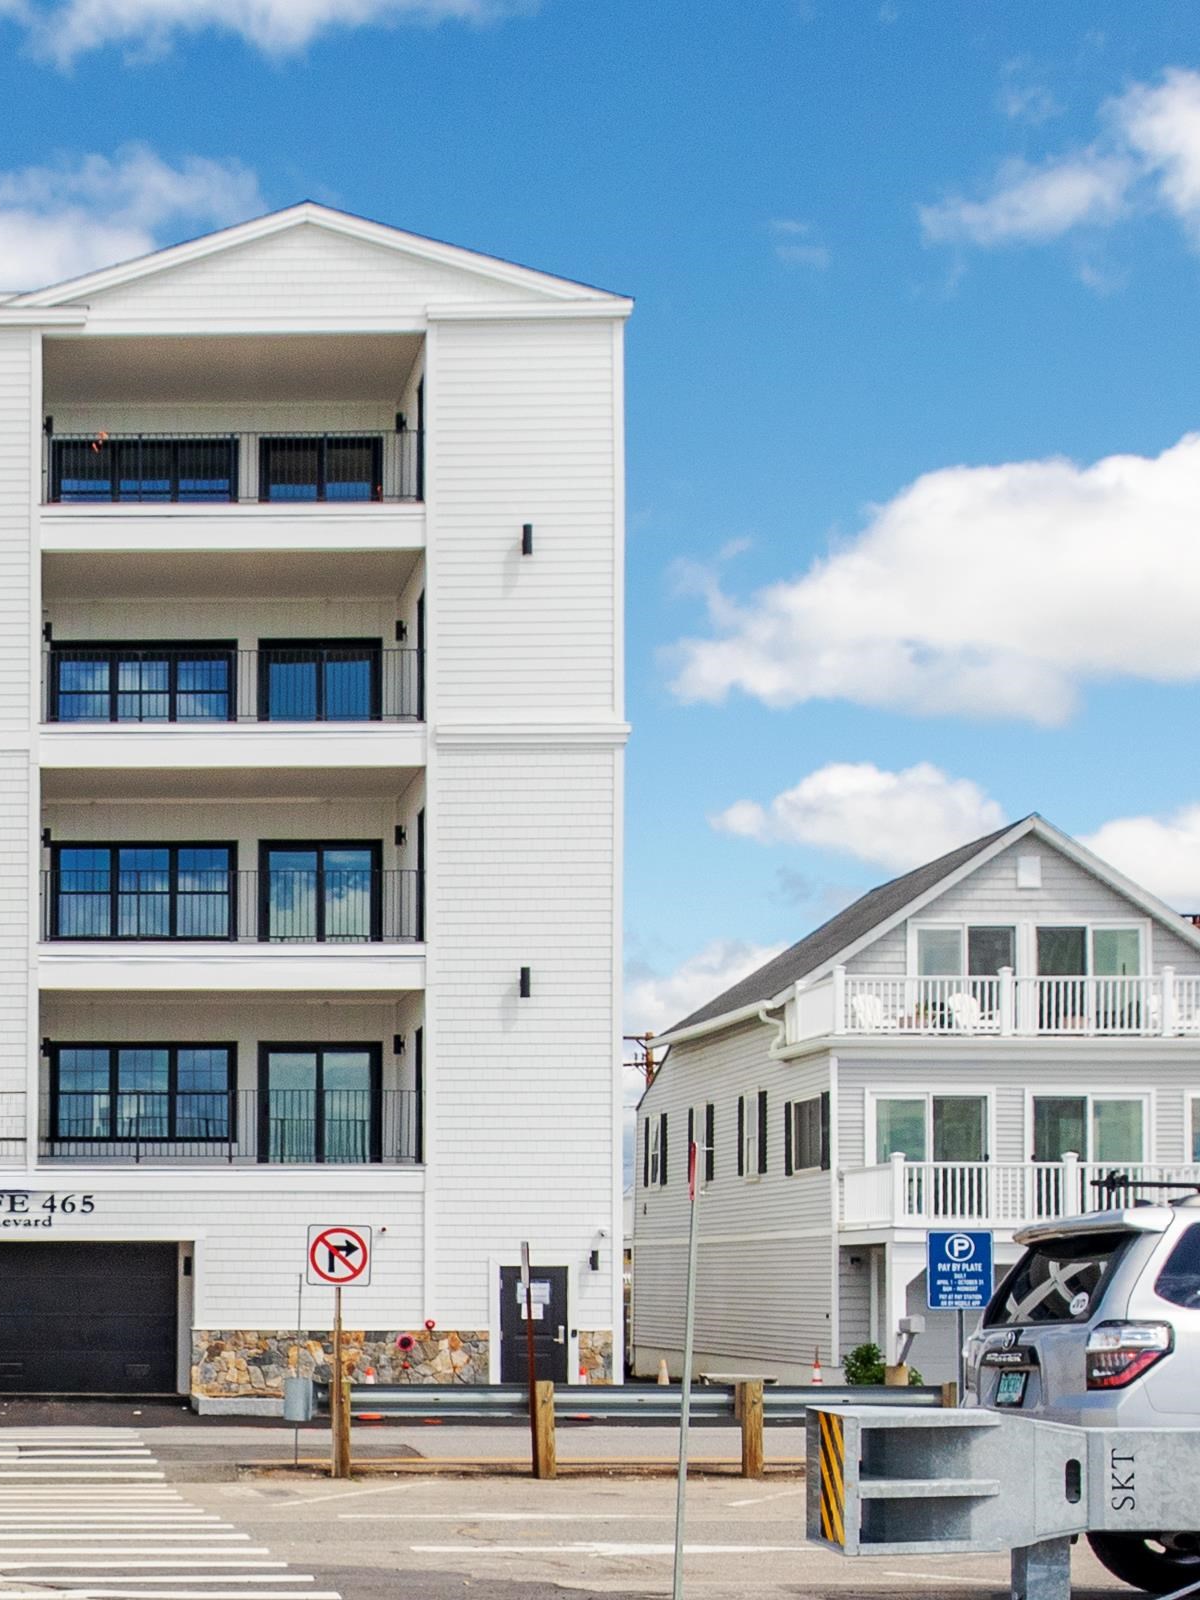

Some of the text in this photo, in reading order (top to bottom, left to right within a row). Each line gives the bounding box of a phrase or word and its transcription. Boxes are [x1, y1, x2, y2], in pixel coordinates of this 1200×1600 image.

[42, 1194, 96, 1213] 465
[953, 1238, 970, 1257] P
[937, 1262, 983, 1272] PAY BY PLATE
[1111, 1447, 1136, 1511] SKT
